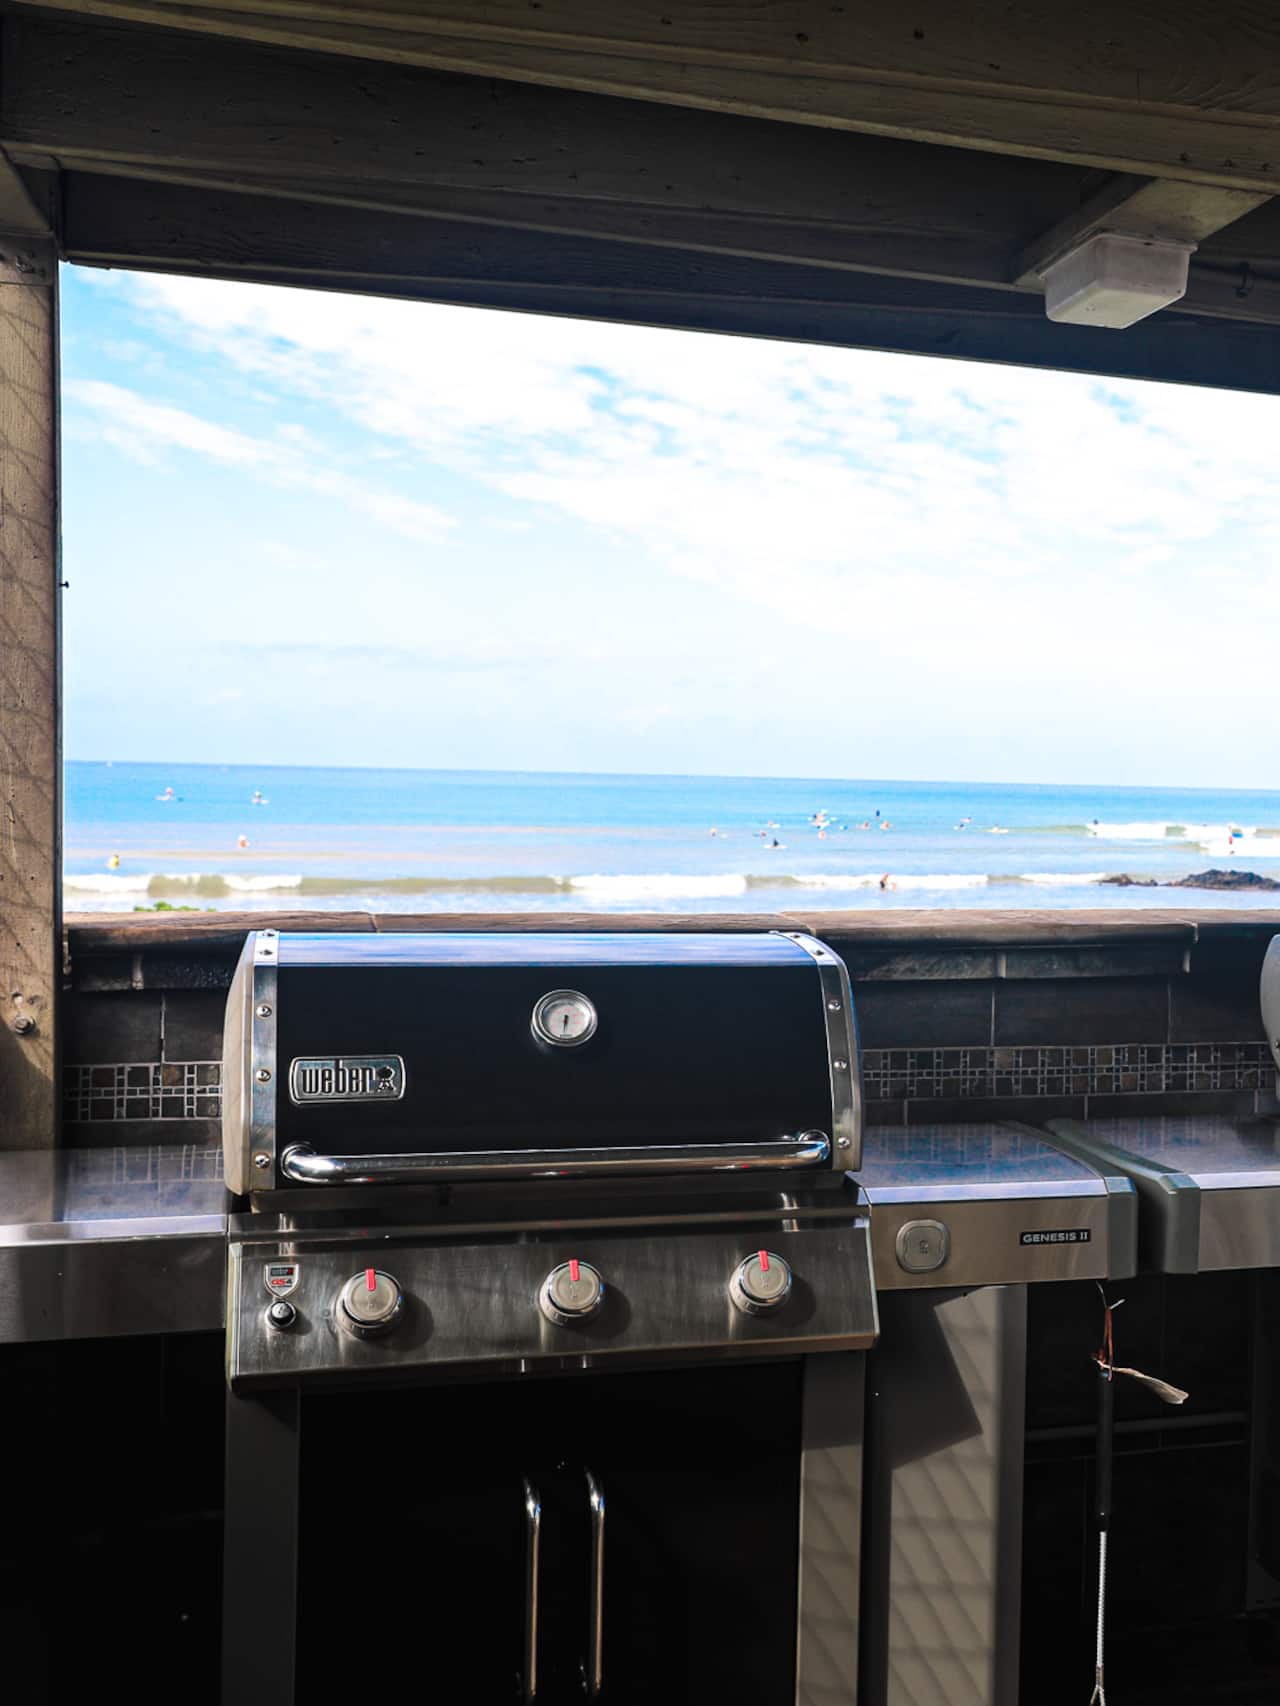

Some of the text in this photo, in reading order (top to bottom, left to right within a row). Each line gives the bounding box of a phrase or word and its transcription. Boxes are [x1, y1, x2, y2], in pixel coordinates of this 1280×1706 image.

[301, 1059, 377, 1096] weber
[1023, 1231, 1088, 1244] GENESIS II
